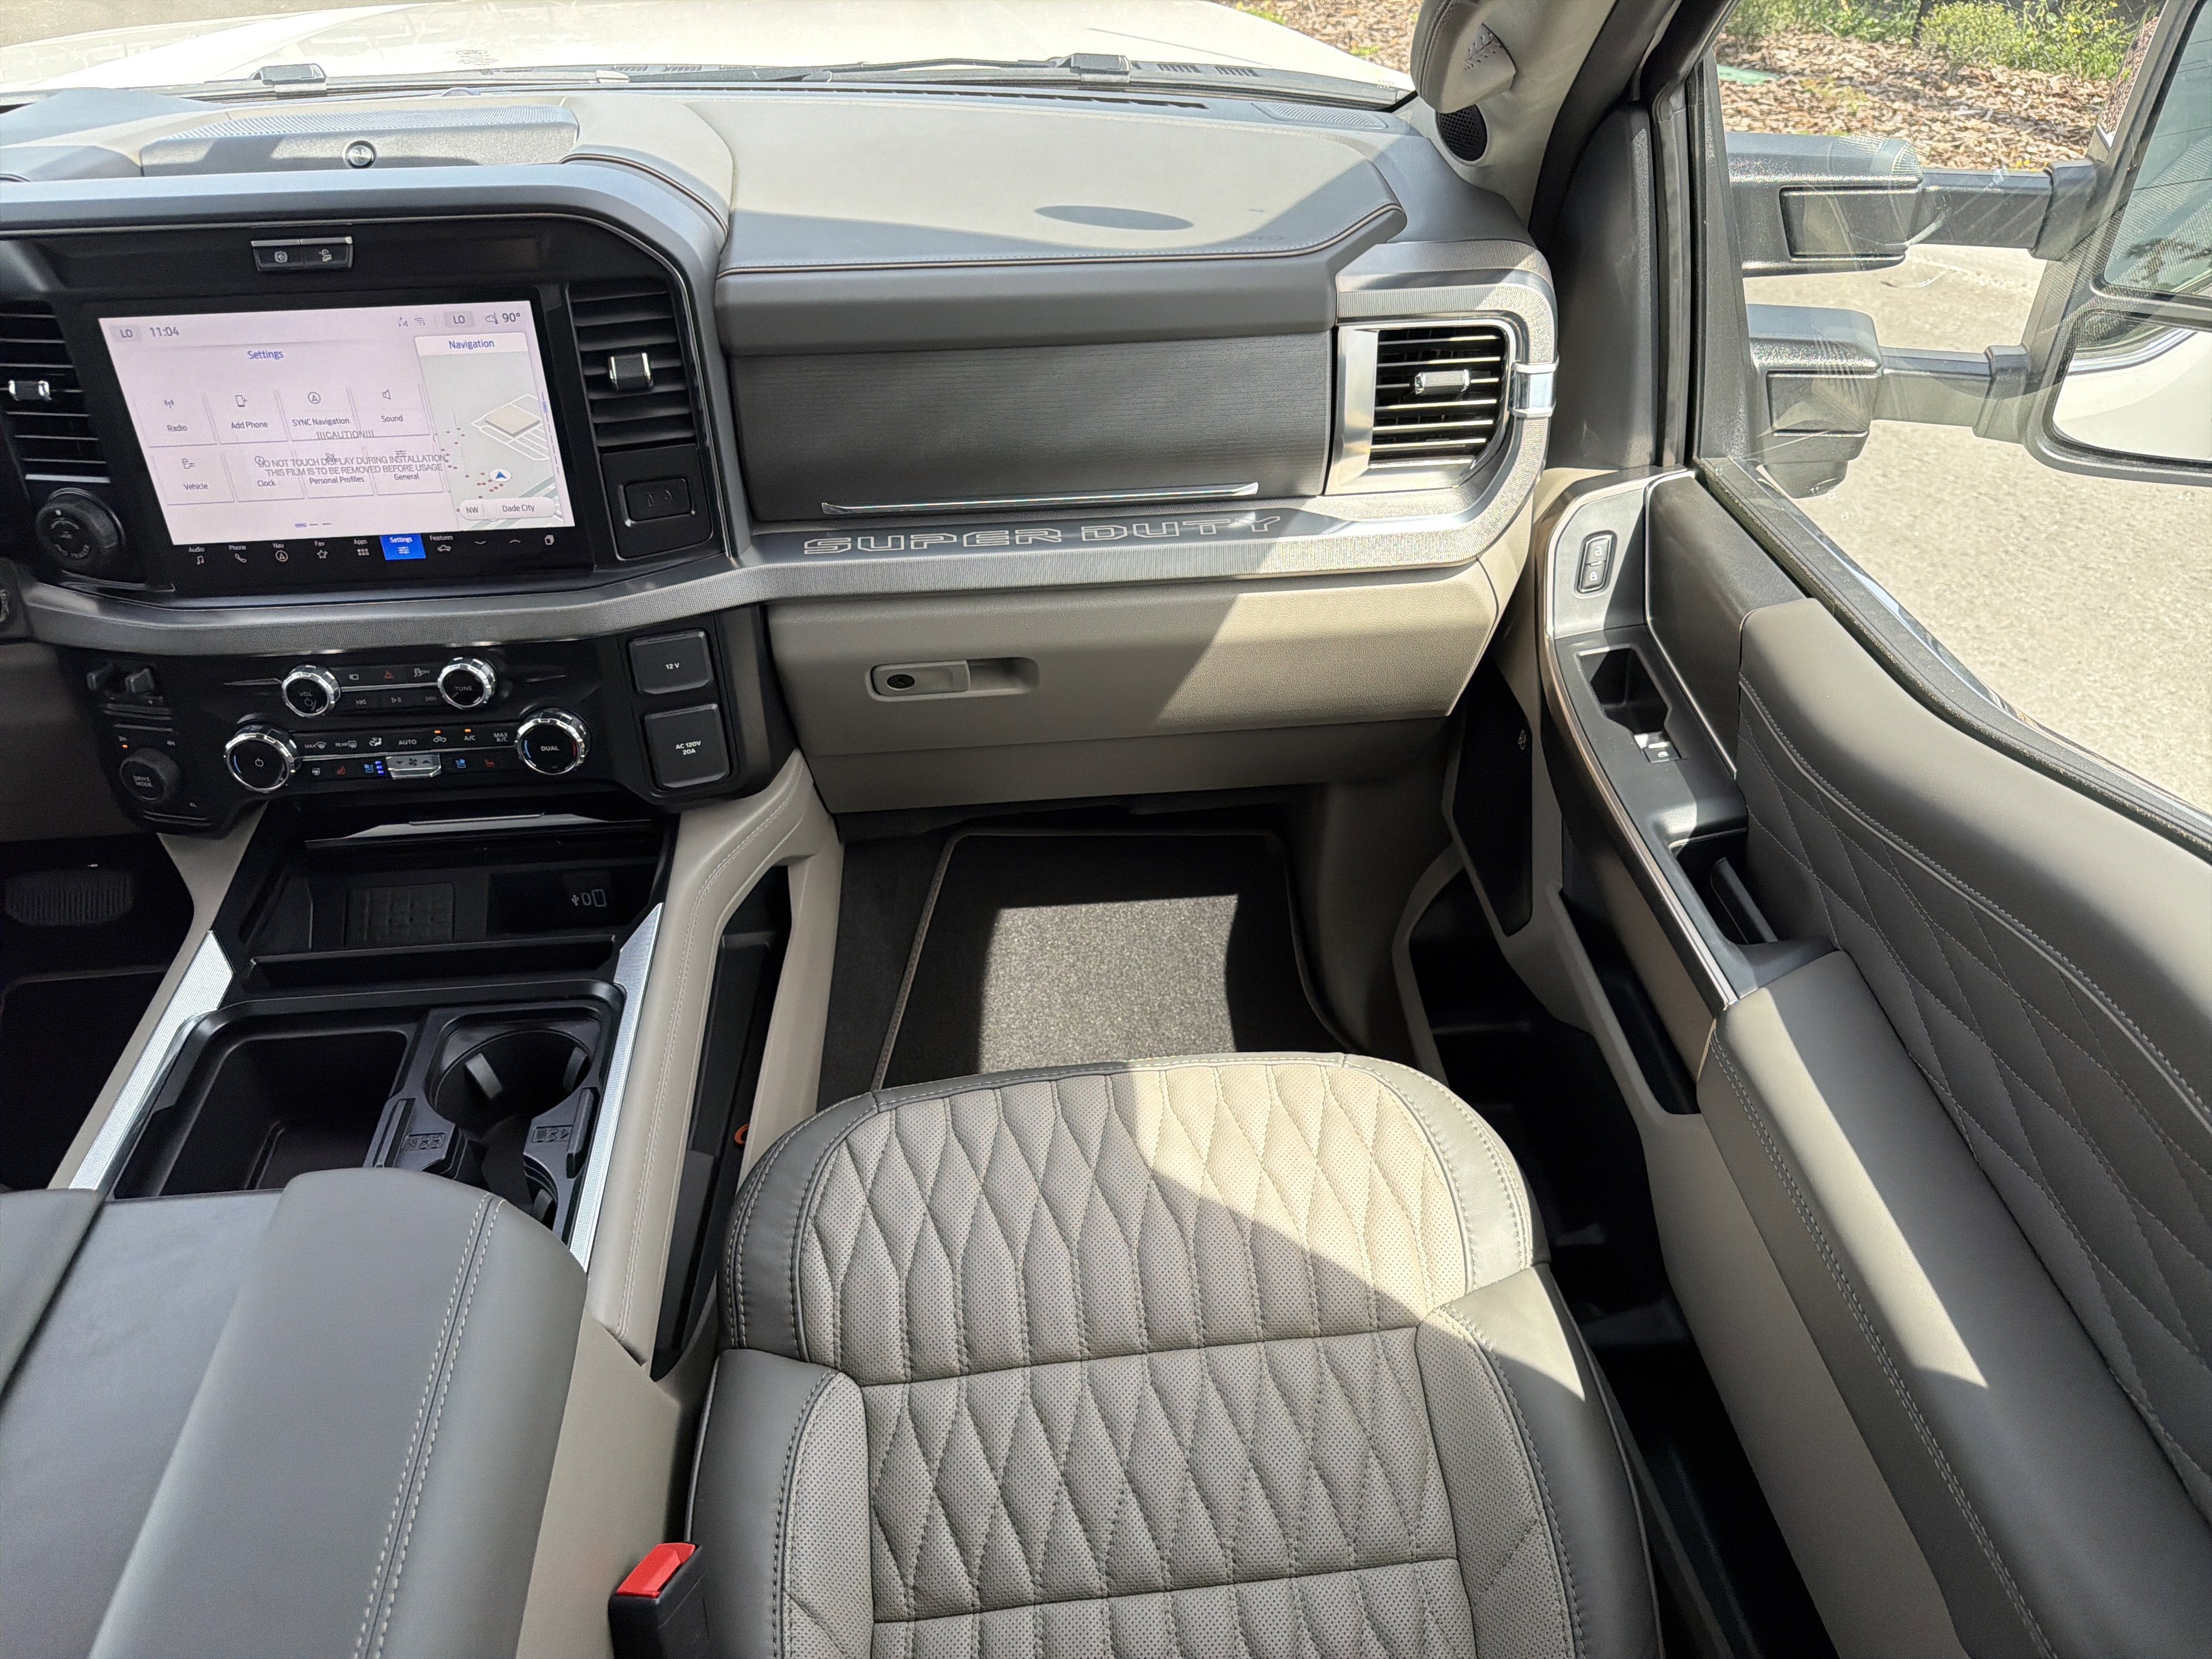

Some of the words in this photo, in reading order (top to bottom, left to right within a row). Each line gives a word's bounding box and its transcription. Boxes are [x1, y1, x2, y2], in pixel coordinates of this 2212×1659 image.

[453, 315, 465, 324] LO
[502, 312, 521, 323] 90°
[121, 329, 133, 338] LO
[150, 326, 179, 337] 11:04
[449, 339, 495, 350] Navigation
[247, 350, 284, 360] Settings
[292, 419, 312, 427] SYNC
[312, 418, 350, 426] Navigation
[381, 415, 403, 423] Sound
[167, 424, 188, 432] Radio
[231, 421, 244, 430] Add
[245, 421, 268, 429] Phone
[290, 458, 320, 466] TOUCH
[321, 457, 354, 466] DISPLAY
[356, 456, 388, 465] DURING
[389, 454, 447, 464] INSTALLATION
[266, 469, 285, 477] THIS
[286, 468, 306, 476] FILM
[315, 467, 328, 475] TO
[342, 465, 381, 474] REMOVED
[382, 464, 415, 473] BEFORE
[415, 464, 443, 472] USAGE
[309, 476, 338, 484] Personal
[340, 476, 365, 484] Profiles
[183, 482, 208, 491] Vehicle
[465, 506, 479, 514] NW
[502, 505, 520, 513] Dade
[521, 504, 535, 513] City
[390, 535, 413, 544] Settings
[804, 527, 1062, 555] SUPER
[1081, 516, 1282, 543] DUTY
